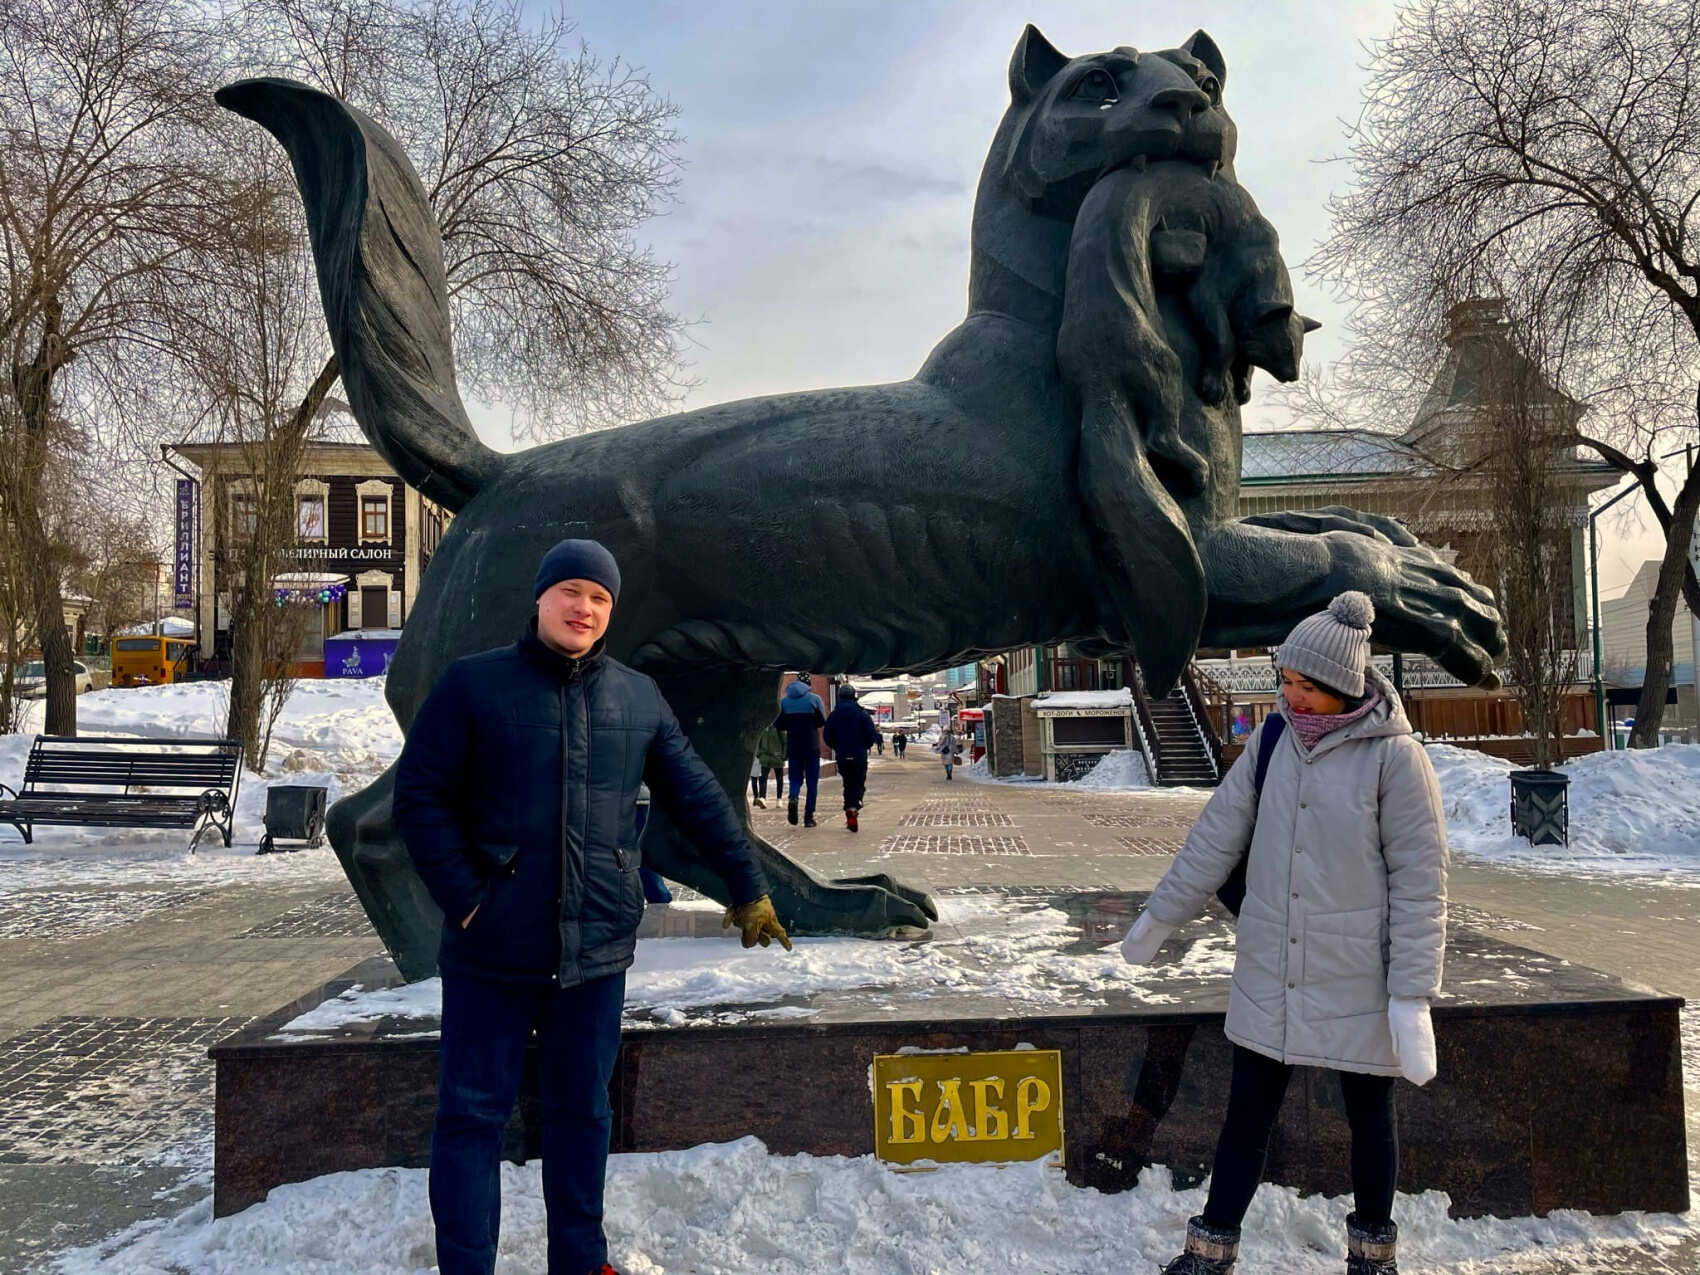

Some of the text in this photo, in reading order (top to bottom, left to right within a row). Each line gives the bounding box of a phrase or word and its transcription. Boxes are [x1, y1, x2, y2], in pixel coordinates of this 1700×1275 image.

[180, 500, 189, 593] БРИЛЛИАНТ
[273, 547, 392, 559] ЕЛИРНЫЙ САЛОН
[342, 667, 363, 675] PAVA
[885, 1077, 1051, 1144] БАБР
